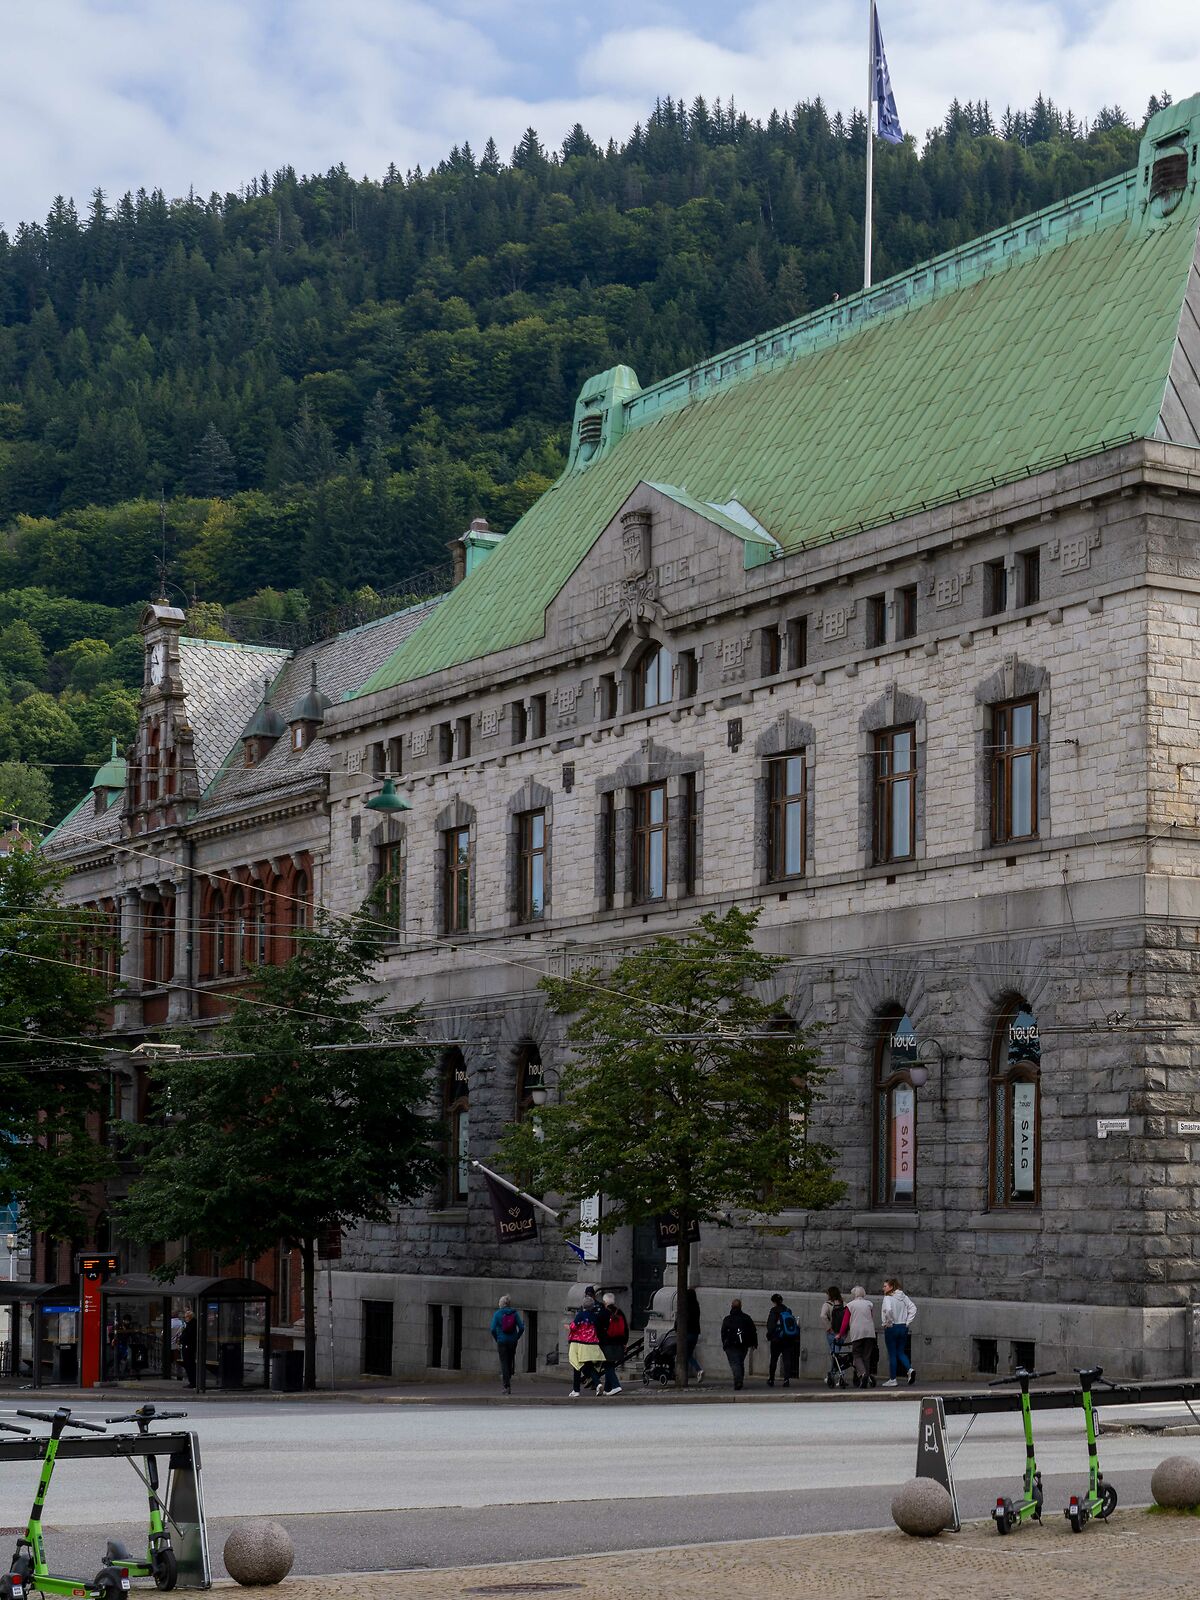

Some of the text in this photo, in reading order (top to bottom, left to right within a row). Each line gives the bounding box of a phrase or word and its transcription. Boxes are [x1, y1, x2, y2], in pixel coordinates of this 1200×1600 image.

[901, 1125, 909, 1172] SALG
[1021, 1120, 1029, 1169] SALG
[500, 1218, 533, 1234] høyer
[925, 1424, 932, 1442] P
